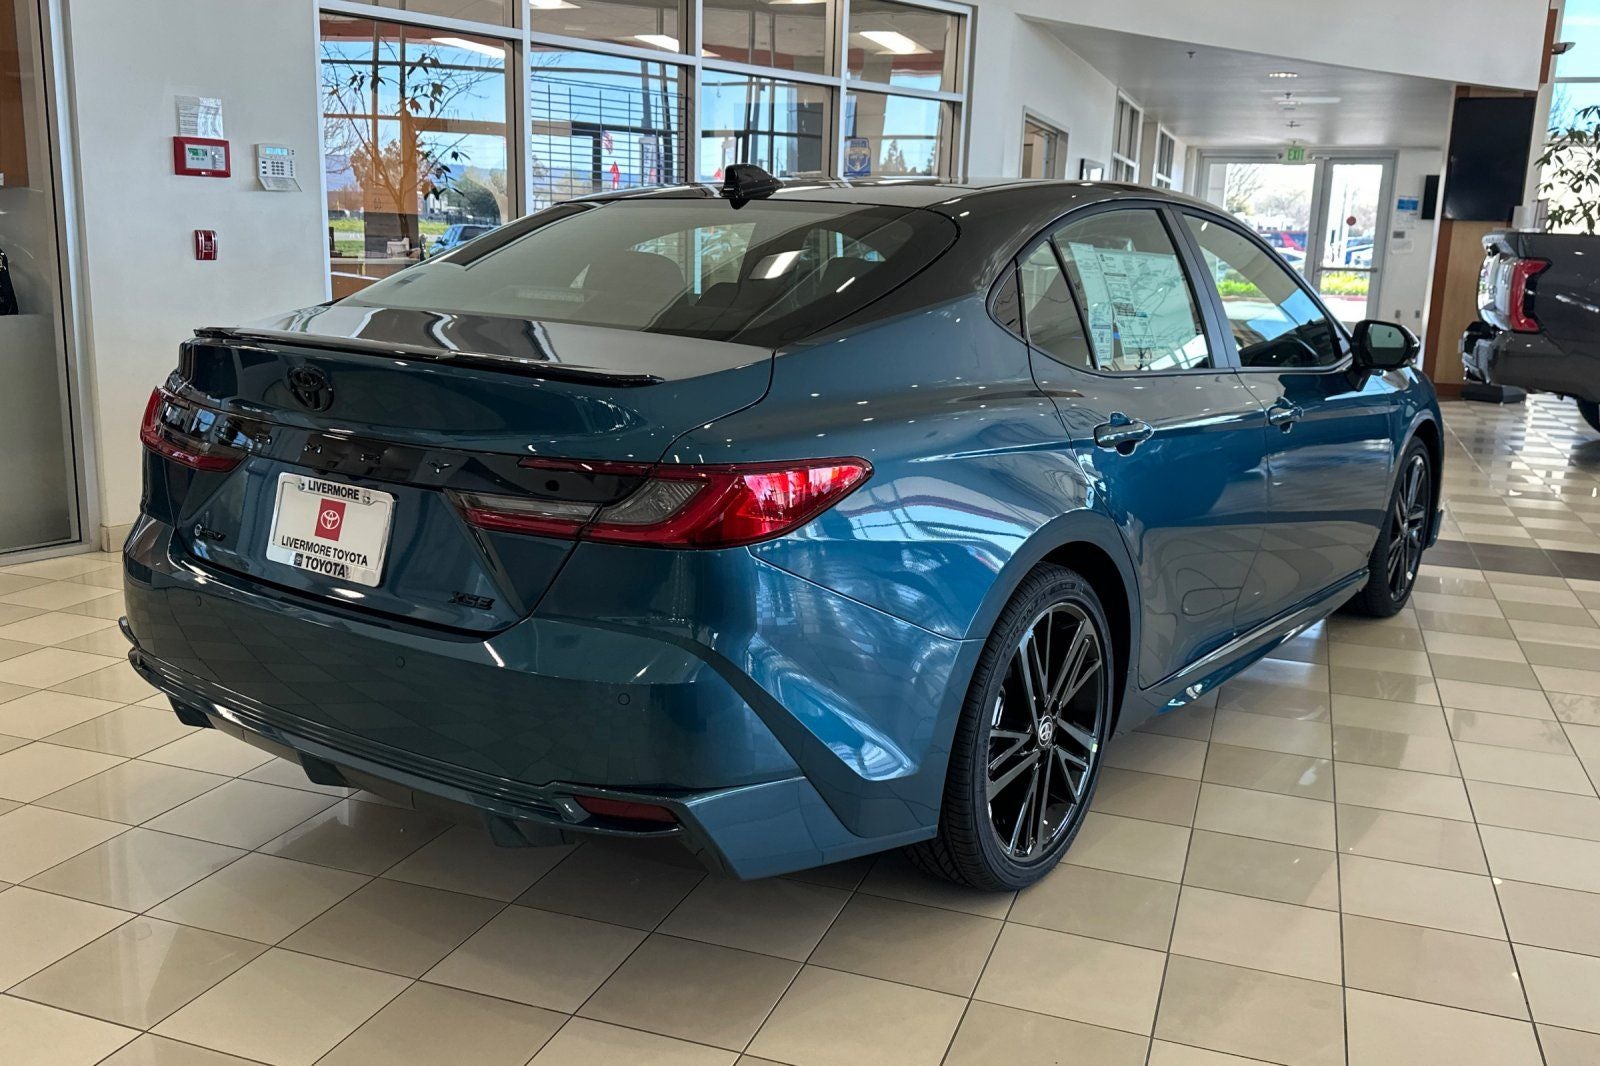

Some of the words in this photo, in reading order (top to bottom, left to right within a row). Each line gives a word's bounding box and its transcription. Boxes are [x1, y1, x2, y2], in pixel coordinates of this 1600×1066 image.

[1288, 149, 1305, 160] EXIT
[308, 480, 360, 500] LIVERMORE
[281, 535, 331, 557] LIVERMORE
[332, 548, 368, 566] TOYOTA
[305, 555, 346, 578] TOYOTA
[448, 591, 496, 610] XSE
